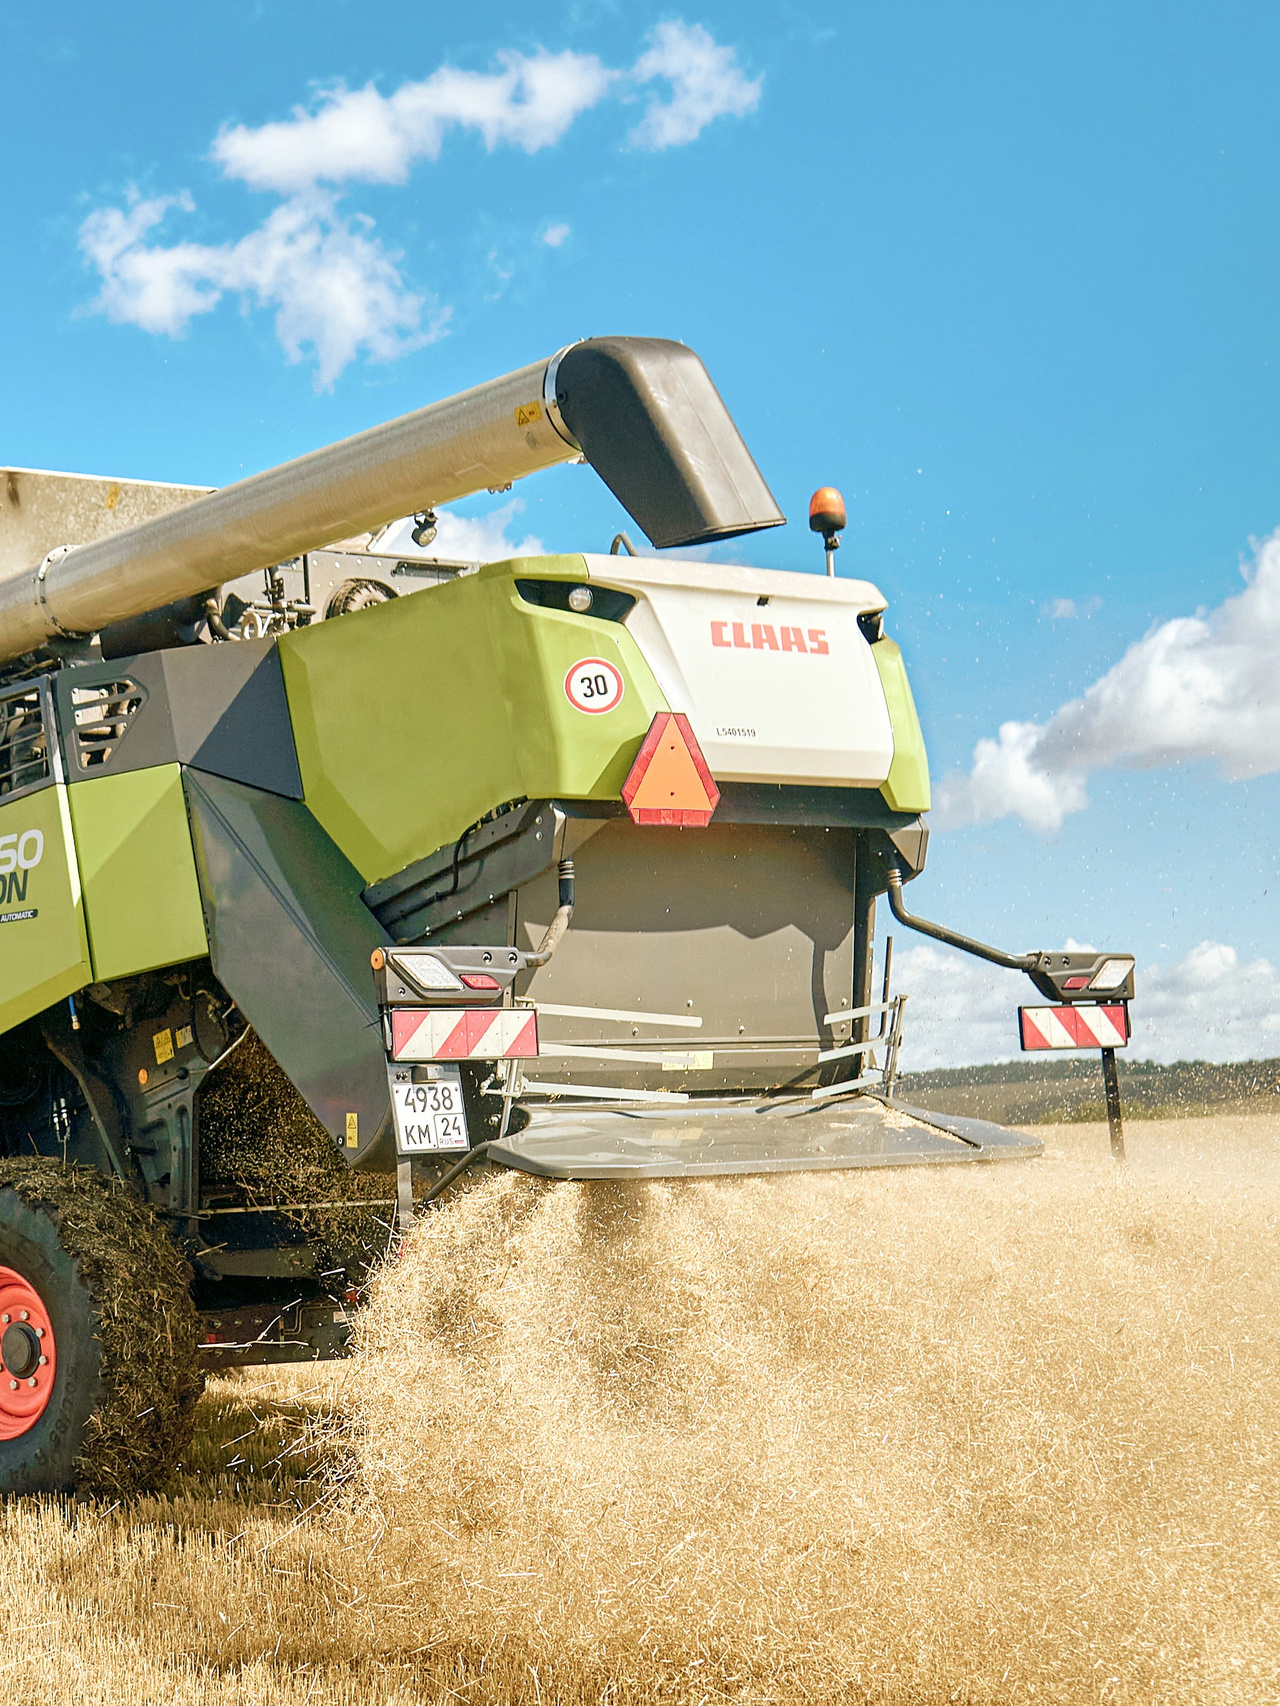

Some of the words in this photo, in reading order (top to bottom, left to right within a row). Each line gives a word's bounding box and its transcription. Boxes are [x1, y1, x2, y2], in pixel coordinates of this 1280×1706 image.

[710, 620, 830, 656] CLAAS
[580, 674, 608, 698] 30
[1, 911, 34, 922] AUTOMATIC
[405, 1087, 453, 1112] 4938
[441, 1117, 461, 1136] 24
